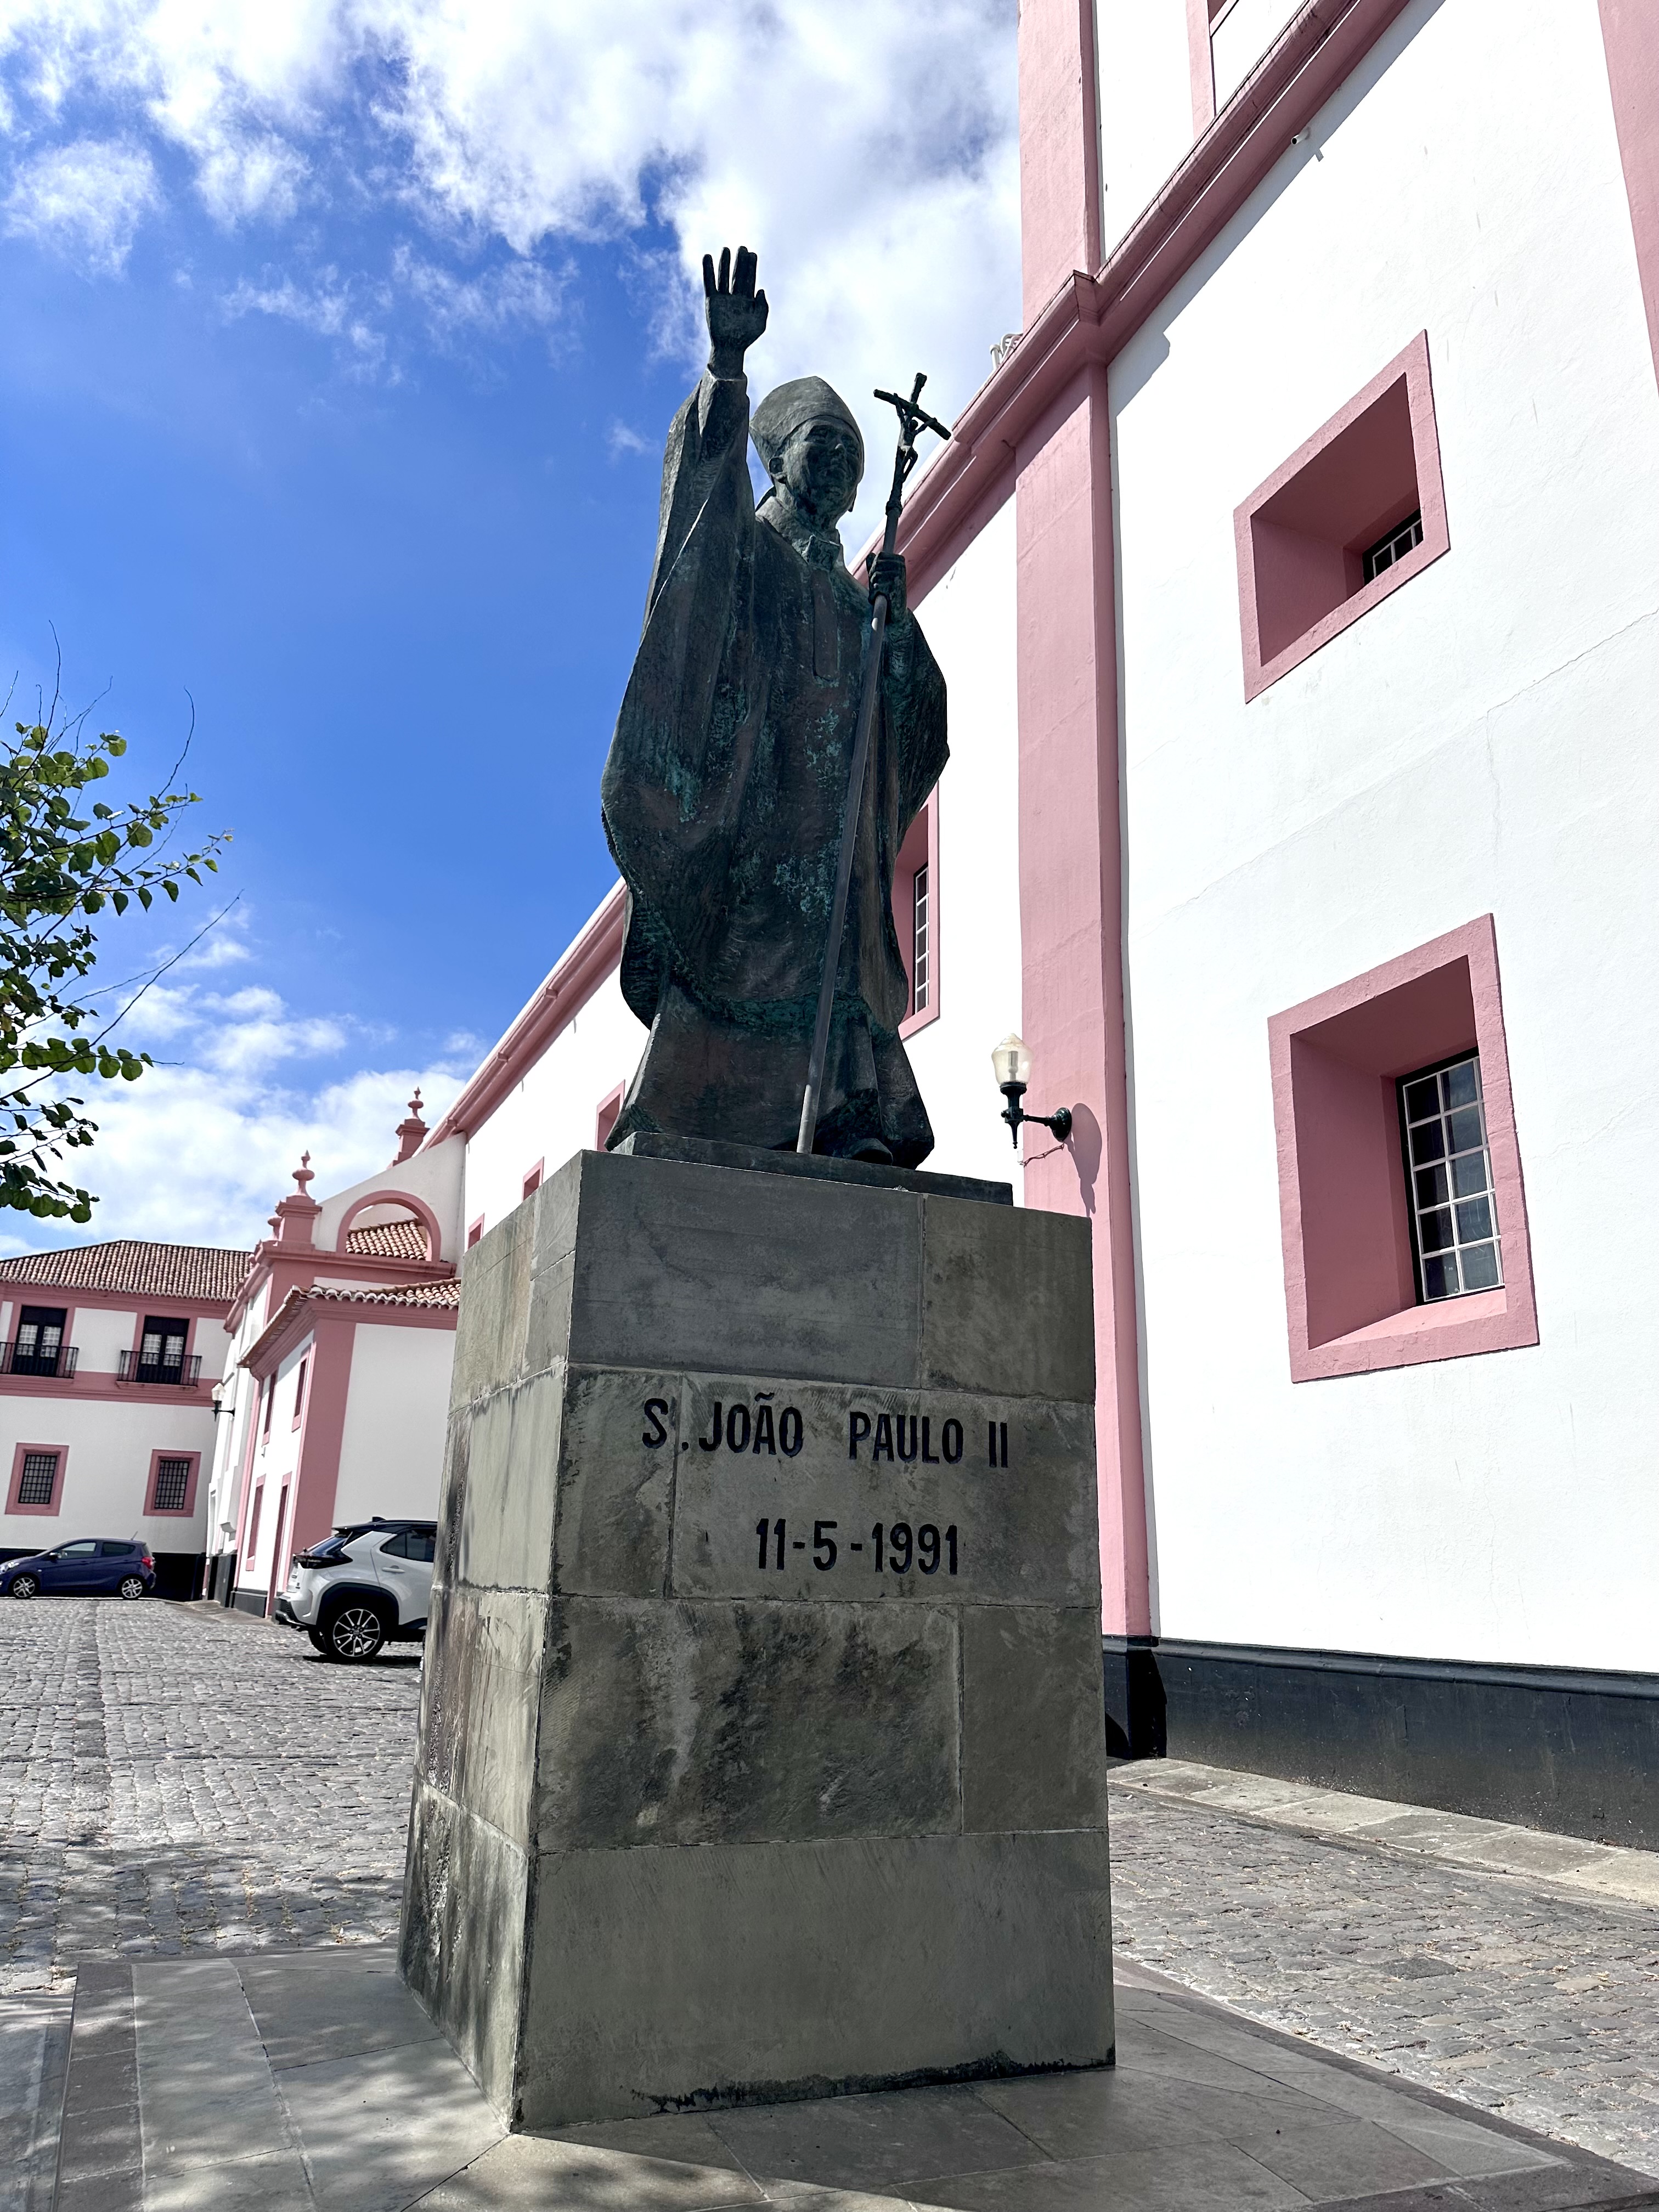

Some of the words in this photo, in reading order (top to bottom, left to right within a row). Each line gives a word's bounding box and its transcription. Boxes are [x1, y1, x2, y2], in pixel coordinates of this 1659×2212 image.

[698, 1392, 804, 1458] JOÃO
[849, 1411, 964, 1464] PAULO
[989, 1420, 1008, 1468] II
